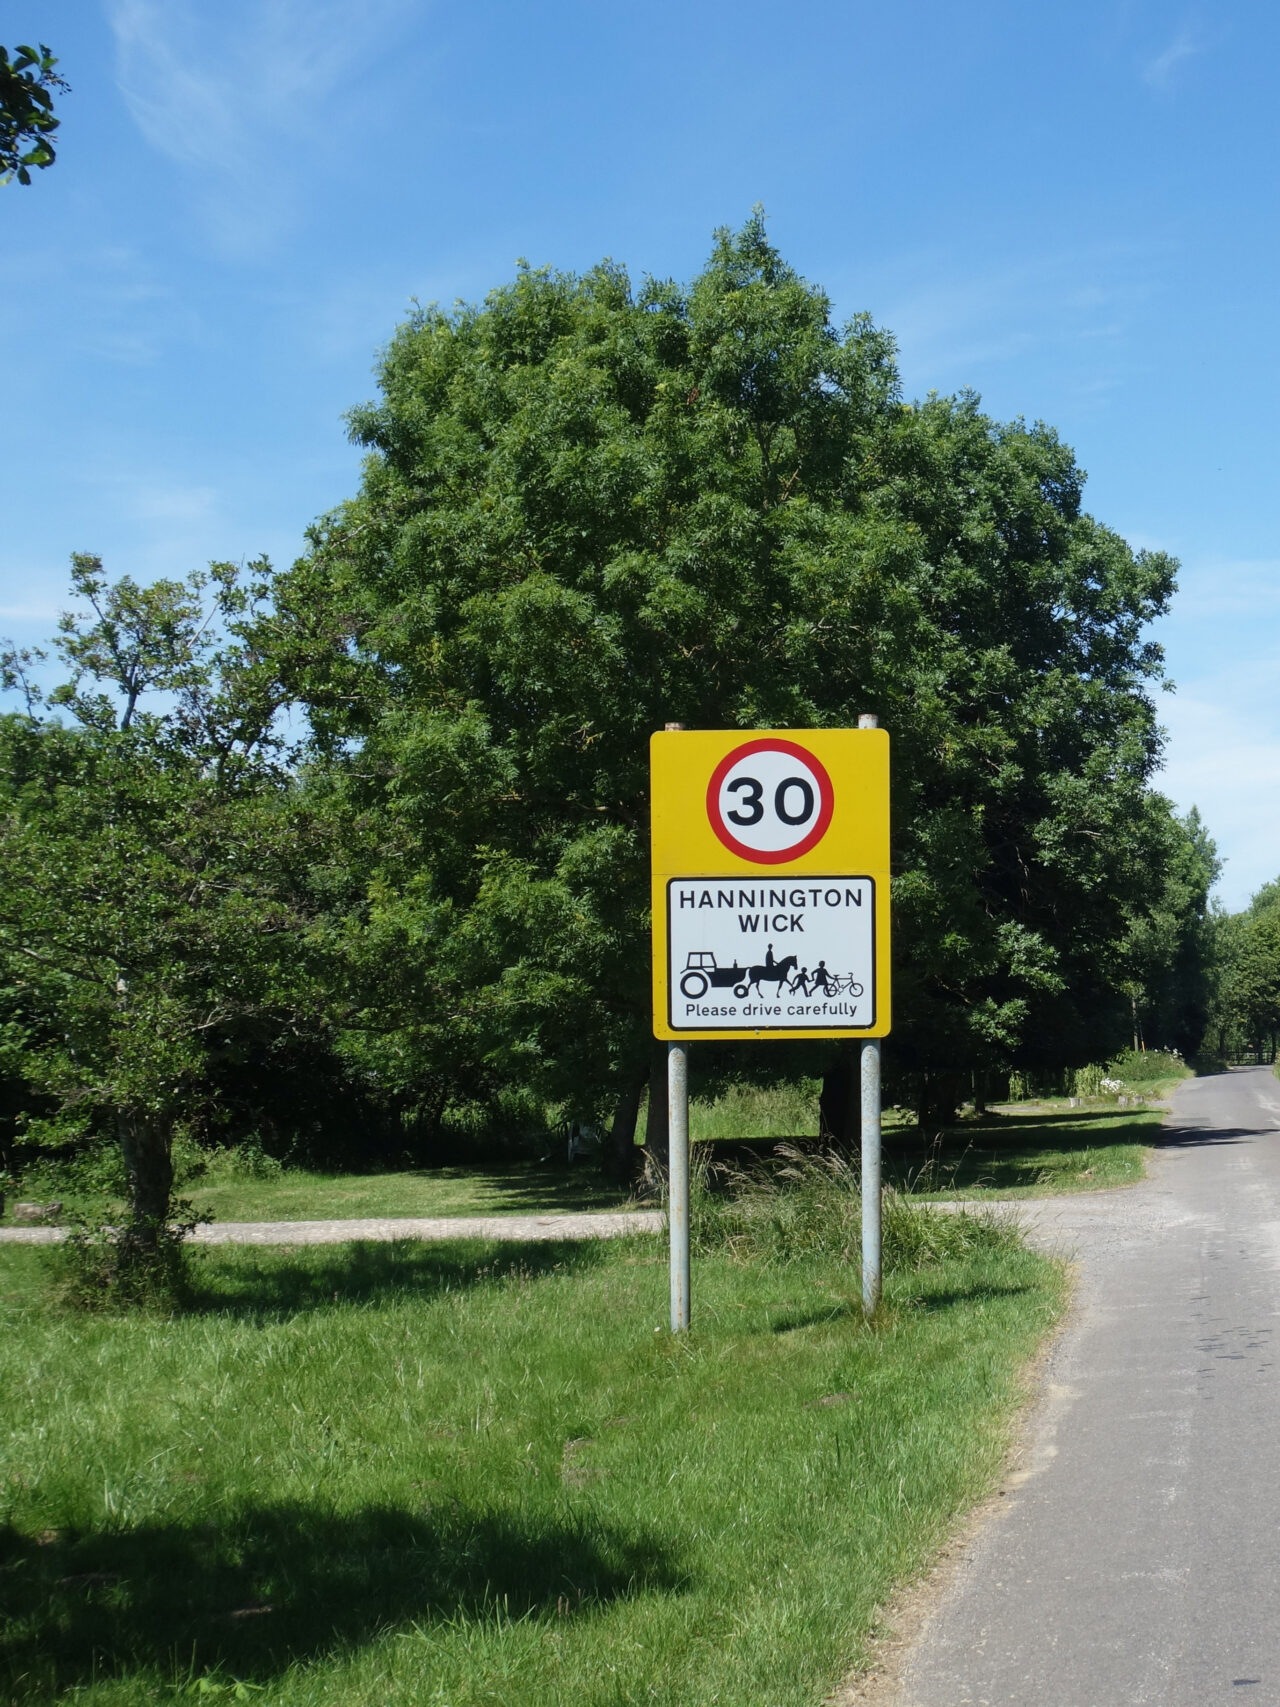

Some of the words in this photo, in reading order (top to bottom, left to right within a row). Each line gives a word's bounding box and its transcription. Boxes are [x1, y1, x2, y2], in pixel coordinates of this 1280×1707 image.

[727, 777, 815, 826] 30
[679, 889, 863, 909] HANNINGTON
[738, 913, 805, 932] WICK
[686, 1003, 737, 1017] Please
[743, 1003, 782, 1015] drive
[787, 1002, 858, 1017] carefully
